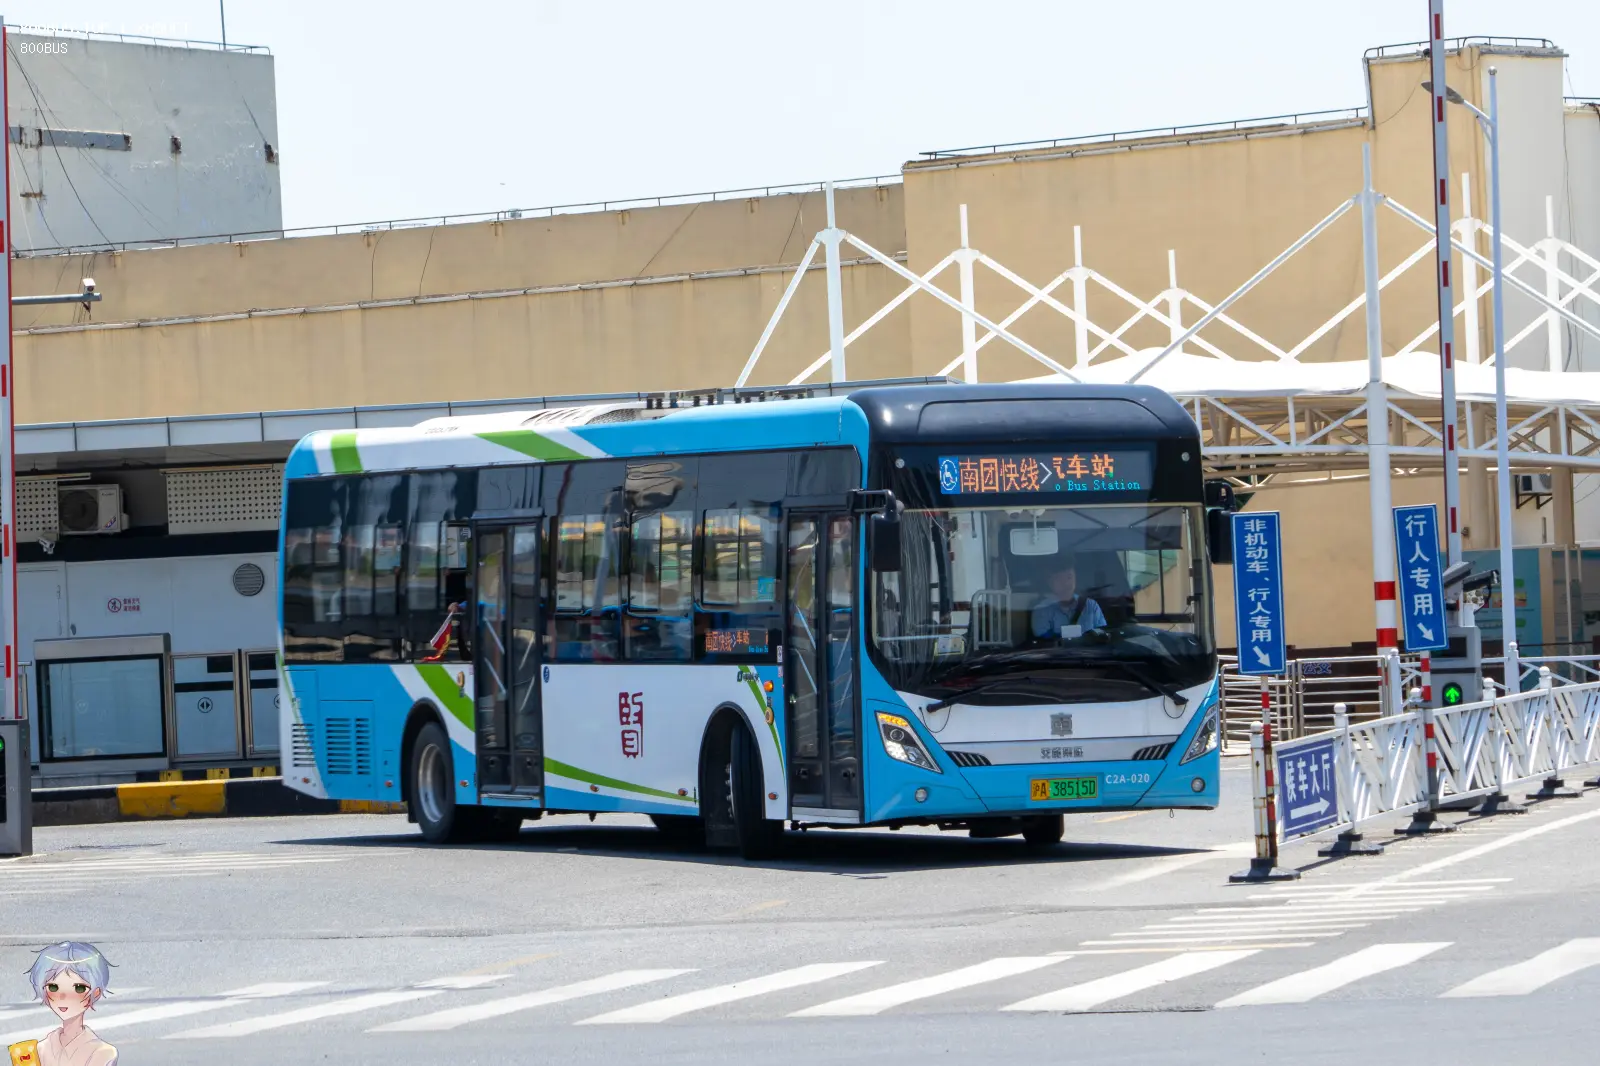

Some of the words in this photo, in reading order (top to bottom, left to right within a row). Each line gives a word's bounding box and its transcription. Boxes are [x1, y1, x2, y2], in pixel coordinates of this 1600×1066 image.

[958, 457, 1040, 493] 南团快线
[1067, 480, 1088, 491] Bus
[1093, 479, 1141, 491] Station
[1243, 519, 1273, 643] 非机动车、行人专用
[1405, 515, 1435, 617] 行人专用
[1032, 781, 1047, 797] 沪A
[1053, 779, 1096, 797] 38515D
[1105, 773, 1150, 785] C2A-020
[1285, 752, 1331, 804] 候车大厅
